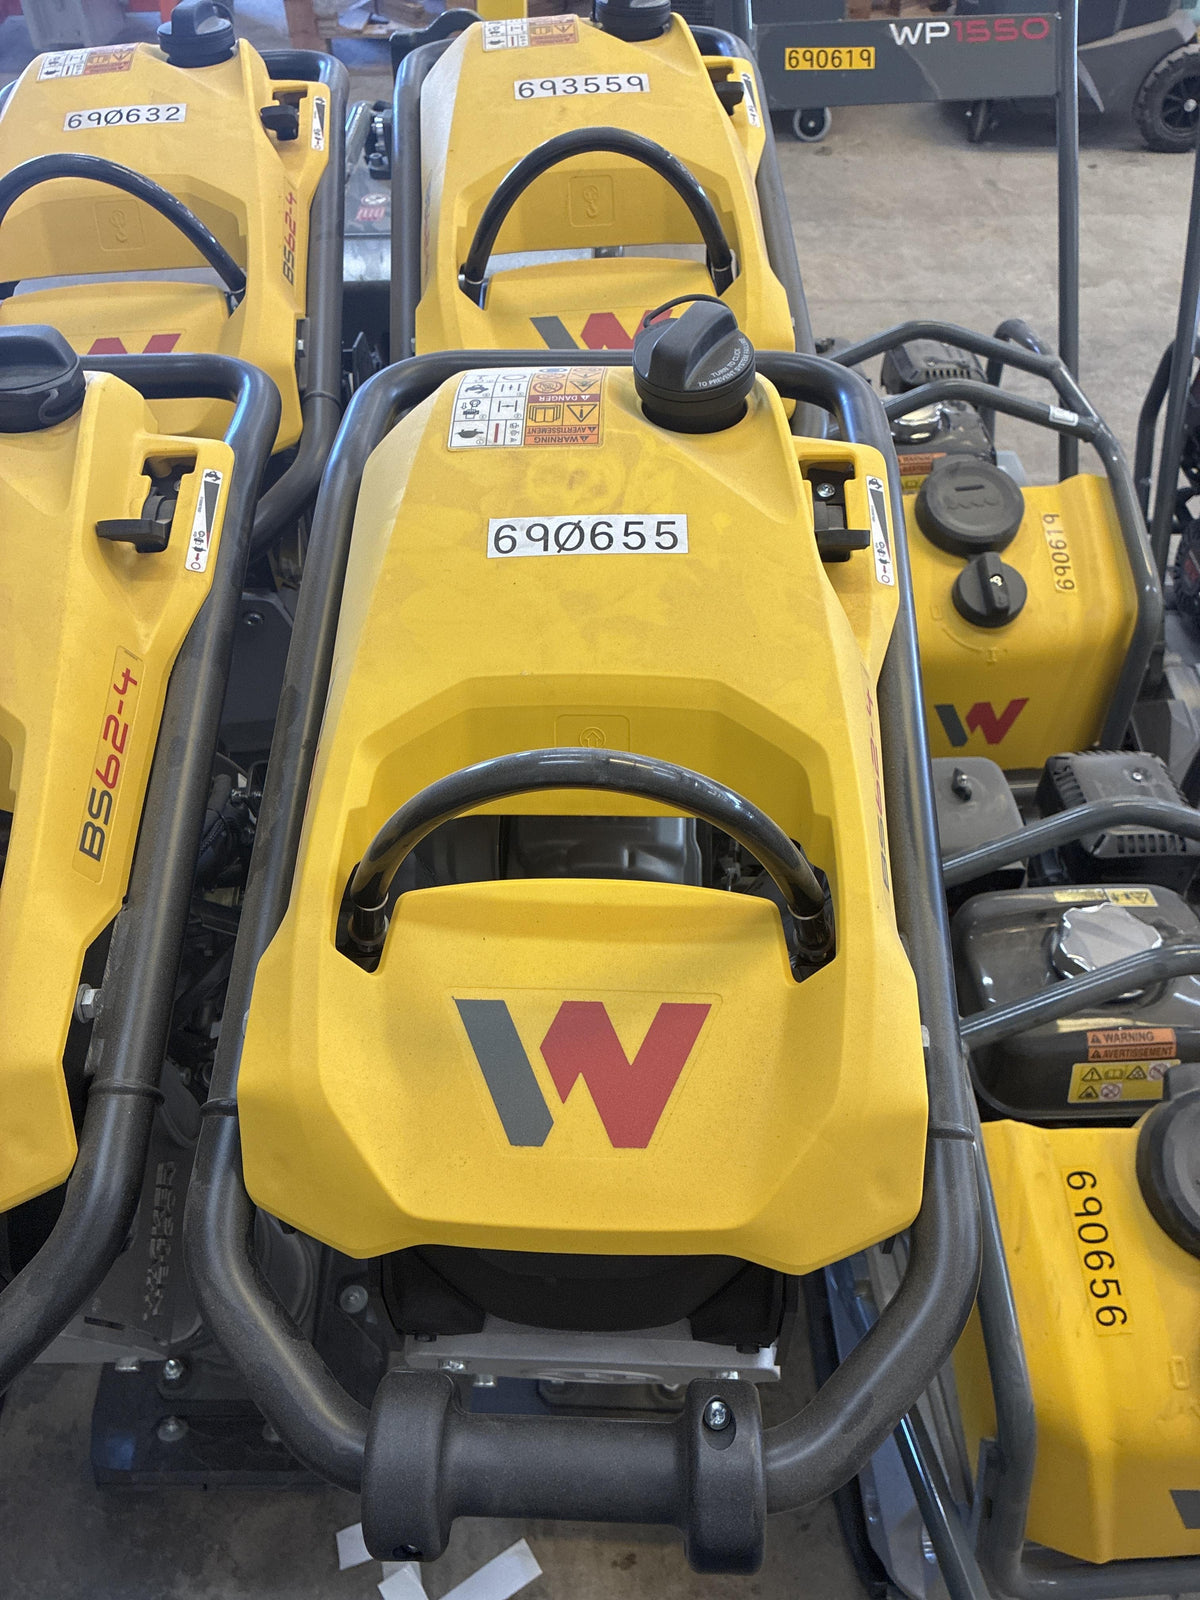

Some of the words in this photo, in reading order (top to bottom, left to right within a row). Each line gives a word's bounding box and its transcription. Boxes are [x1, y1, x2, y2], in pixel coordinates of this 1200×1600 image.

[889, 17, 1050, 46] WP1550
[787, 49, 872, 70] 690619
[518, 76, 646, 99] 693559
[282, 191, 297, 286] BS62-4
[709, 371, 735, 384] PREVENT
[711, 366, 729, 378] TURN
[727, 360, 736, 369] TO
[539, 394, 578, 402] DANGER
[527, 426, 587, 435] AVERTISSEMENT
[533, 435, 579, 444] WARNING
[1043, 513, 1075, 592] 690619
[78, 668, 138, 862] BS62-4
[1103, 1031, 1155, 1043] WARNING
[1102, 1046, 1174, 1059] AVERTISSEMENT
[1066, 1170, 1128, 1327] 690656
